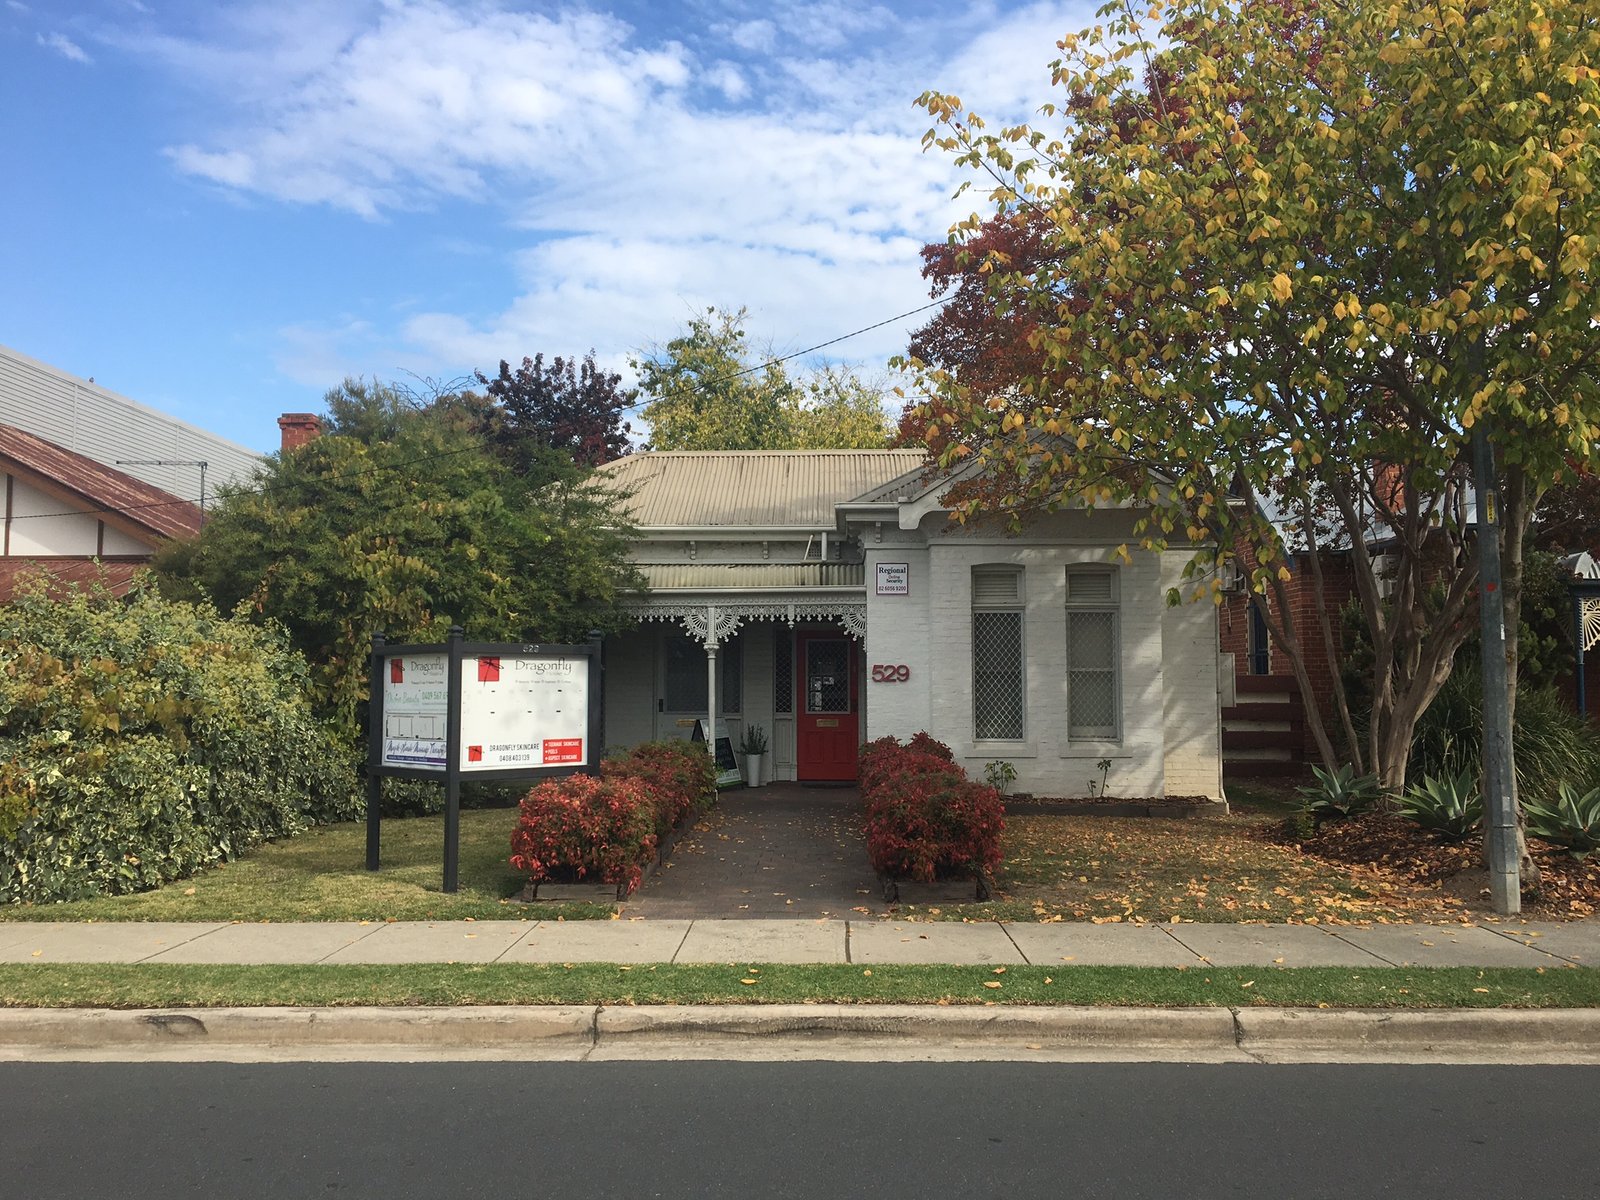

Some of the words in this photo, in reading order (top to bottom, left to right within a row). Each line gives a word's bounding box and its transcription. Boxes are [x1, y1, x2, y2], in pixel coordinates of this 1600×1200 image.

[411, 656, 445, 675] Dragonfly
[515, 657, 572, 675] Dragonfly
[872, 664, 910, 682] 529
[489, 744, 516, 752] DRAGONFLY
